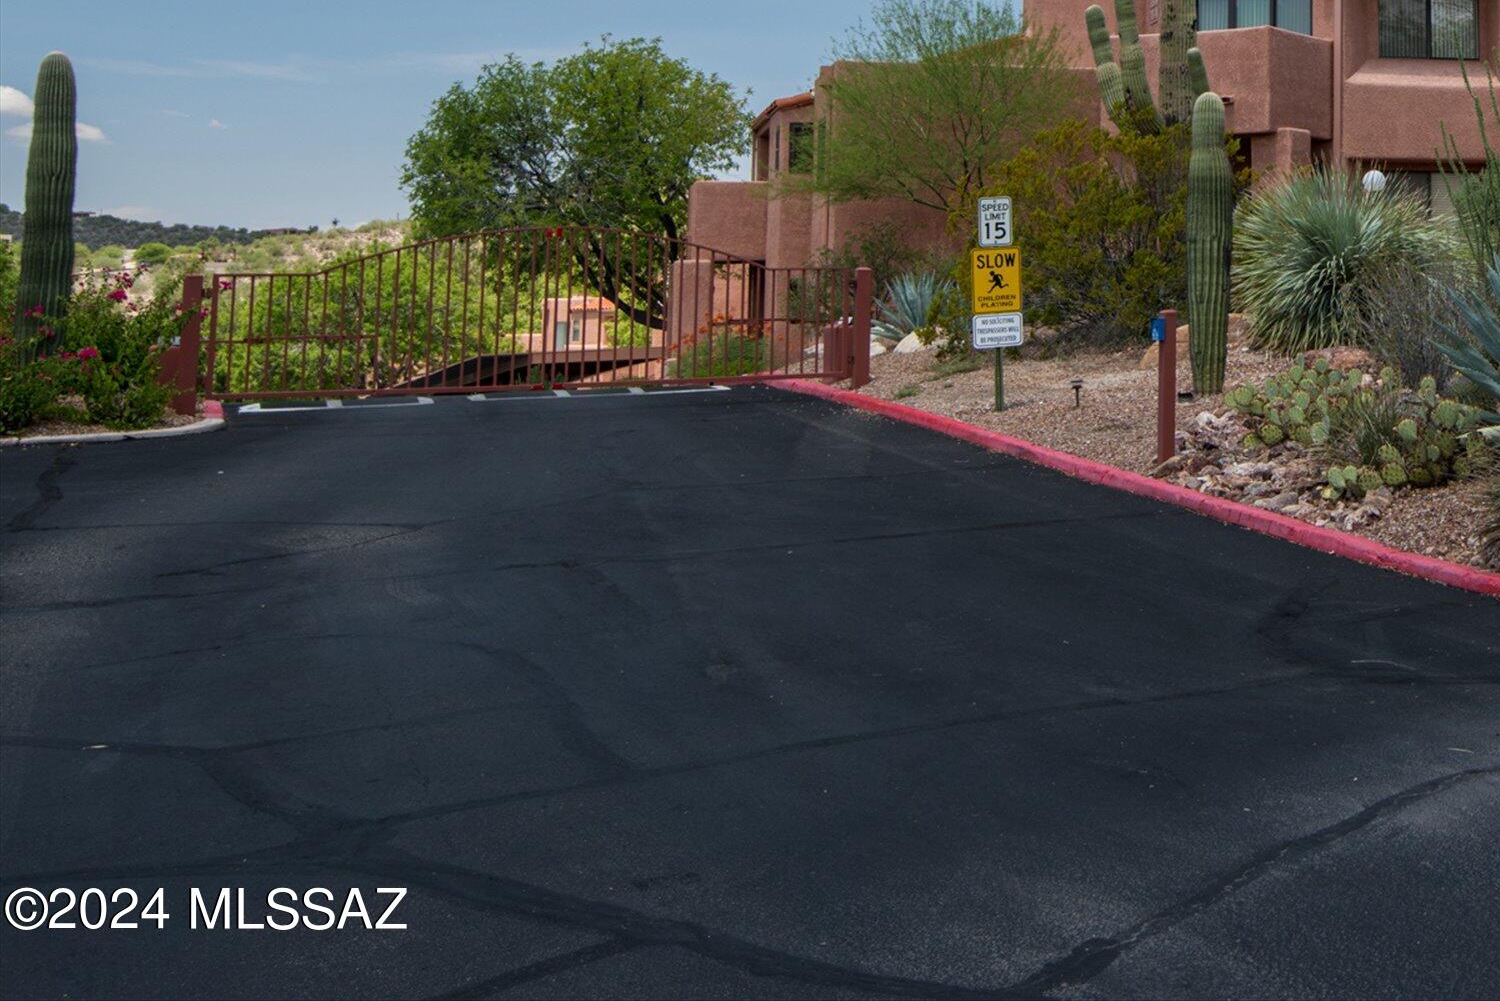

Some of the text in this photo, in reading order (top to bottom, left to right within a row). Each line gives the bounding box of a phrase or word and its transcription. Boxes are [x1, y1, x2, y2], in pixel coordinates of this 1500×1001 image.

[981, 203, 1009, 212] SPEED
[985, 212, 1006, 221] LIMIT
[985, 222, 1006, 239] 15
[977, 253, 1016, 269] SLOW
